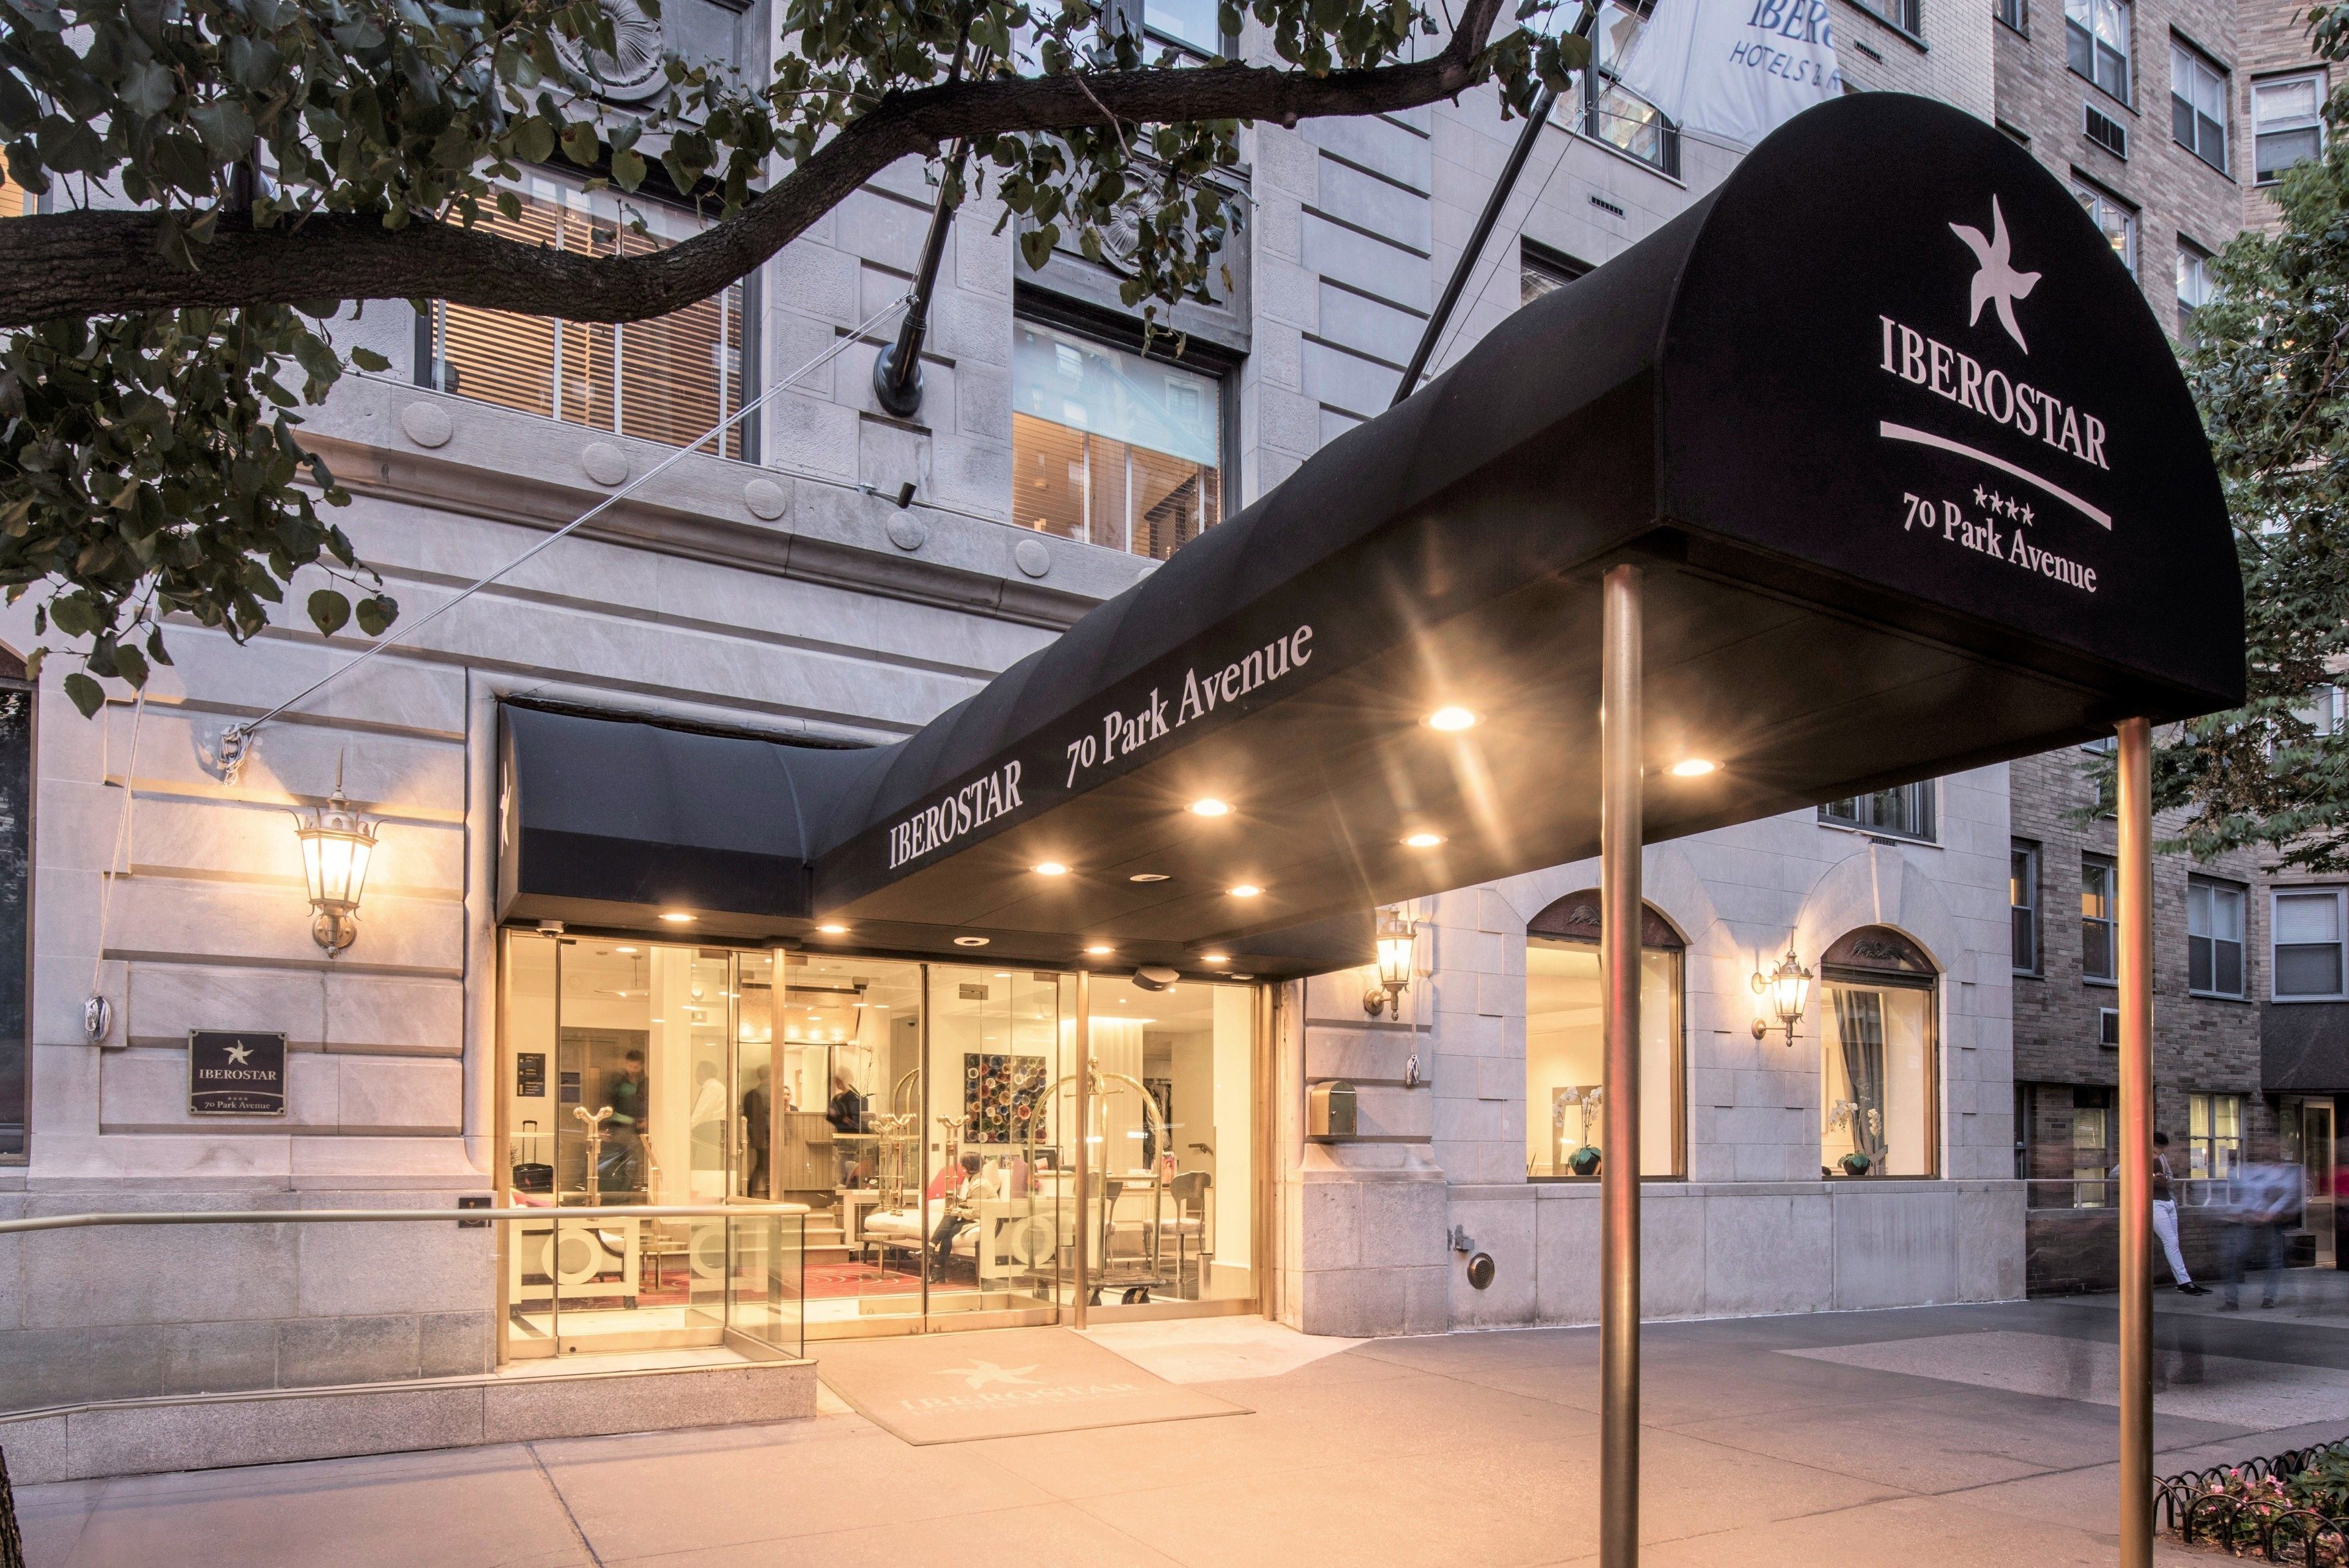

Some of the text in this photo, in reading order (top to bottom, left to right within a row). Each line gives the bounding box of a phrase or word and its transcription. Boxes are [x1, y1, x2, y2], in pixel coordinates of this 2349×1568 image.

[1729, 40, 1809, 81] HOTELS
[1811, 63, 1822, 86] &
[1879, 314, 2110, 470] IBEROSTAR
[1904, 492, 2096, 593] 70 Park Avenue
[889, 625, 1313, 869] IBEROSTAR 70 Park Avenue
[199, 1069, 277, 1080] IBEROSTAR
[900, 1383, 1142, 1410] IBEROSTAR
